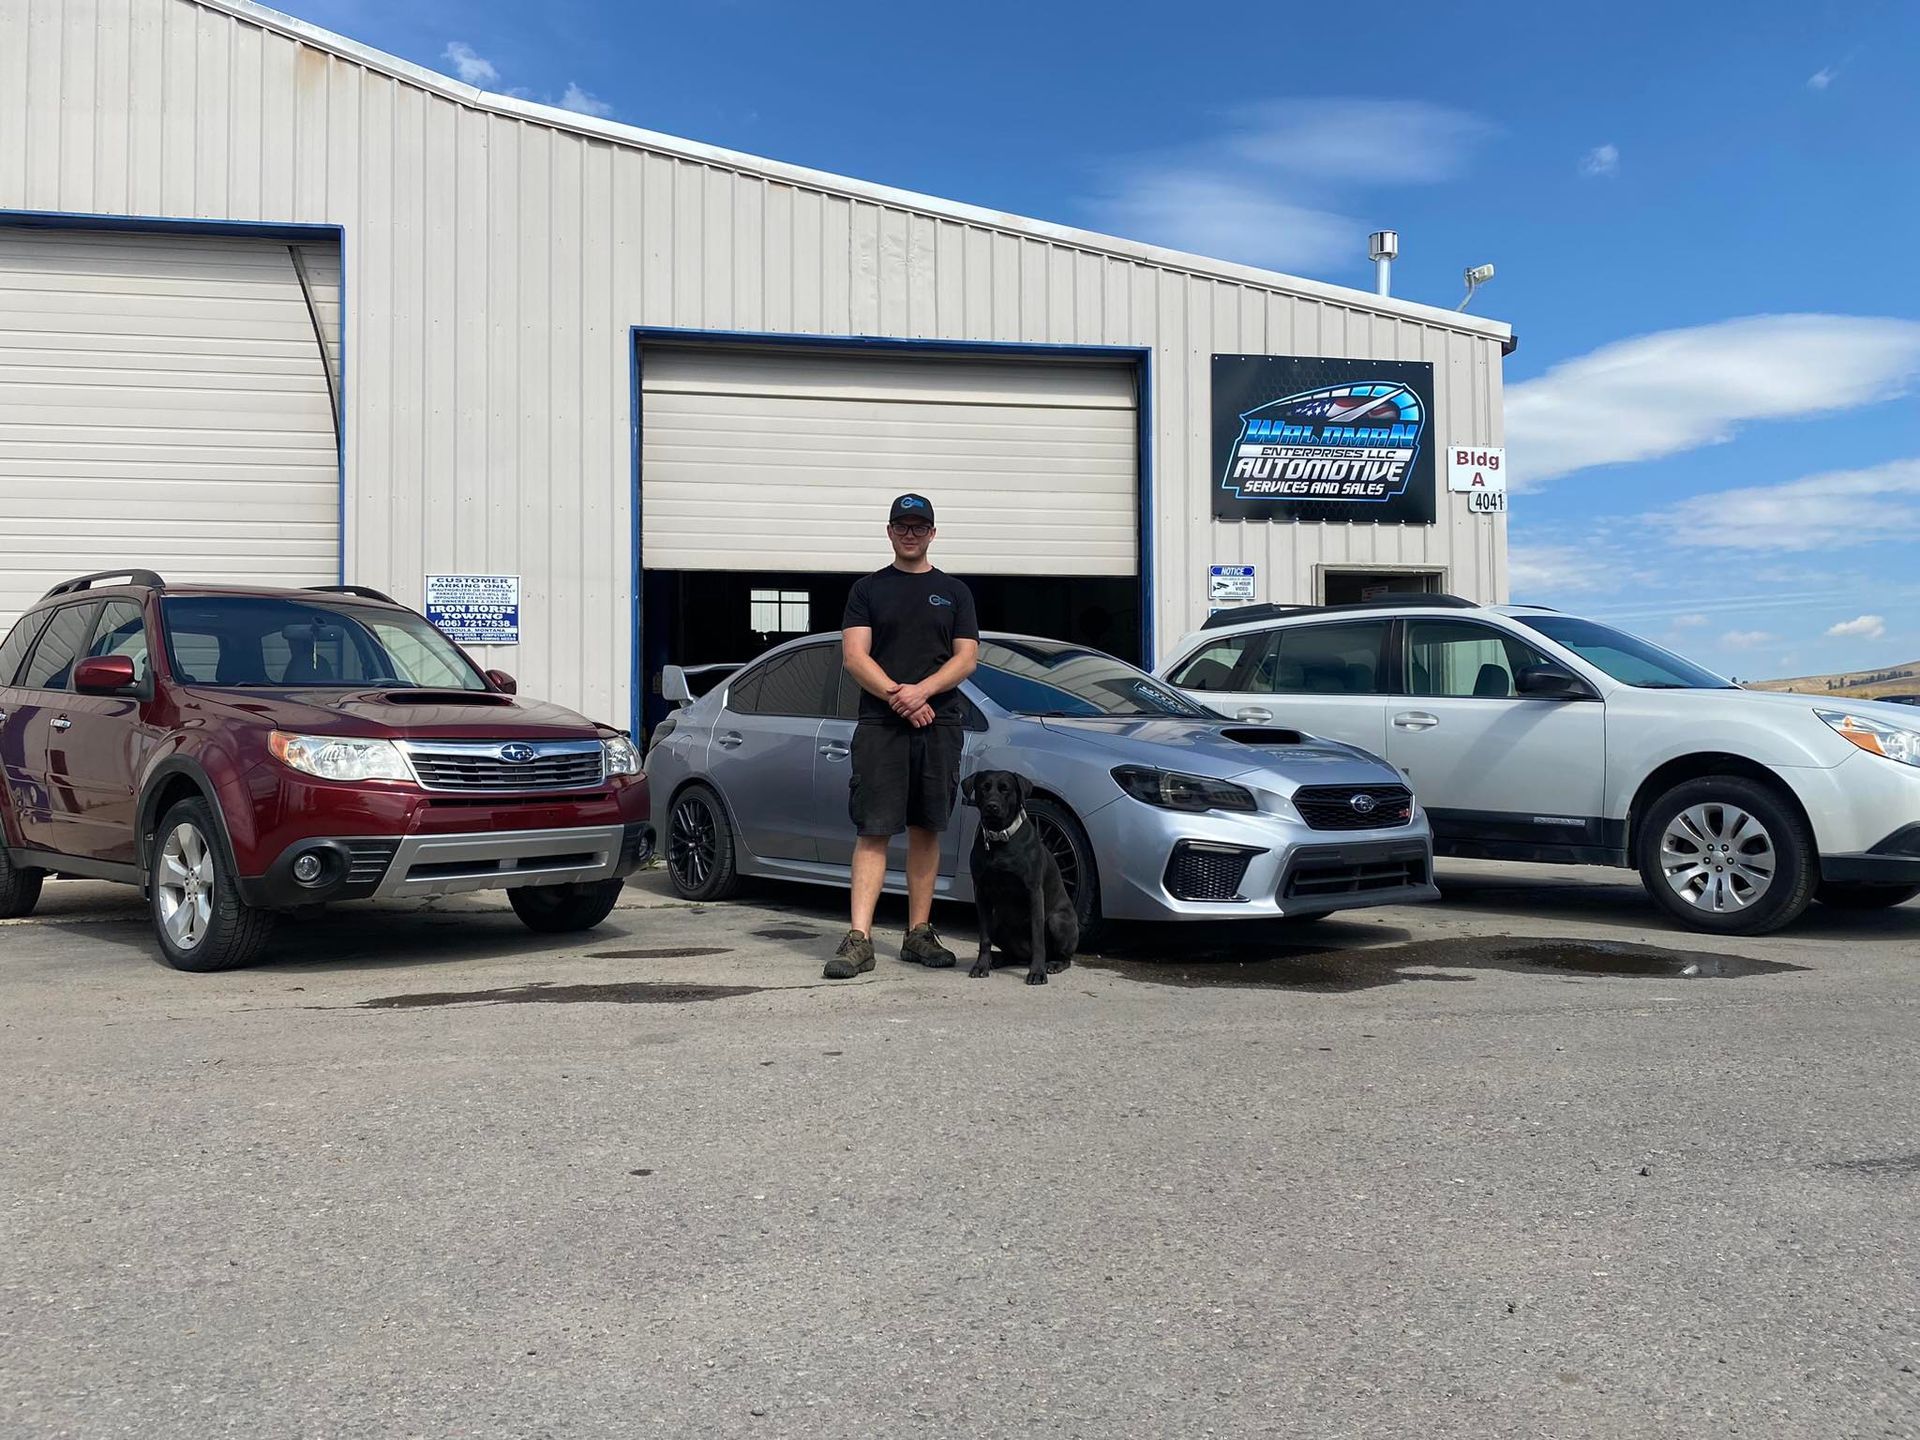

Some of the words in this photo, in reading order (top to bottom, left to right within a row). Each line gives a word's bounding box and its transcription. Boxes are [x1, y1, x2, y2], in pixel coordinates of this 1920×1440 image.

[1242, 418, 1418, 448] WALDMAN
[1261, 447, 1364, 458] ENTERPRISES
[1367, 450, 1396, 460] LLC
[1456, 450, 1500, 470] Bldg
[1233, 457, 1405, 482] AUTOMOTIVE
[1471, 472, 1485, 487] A
[1244, 480, 1308, 494] SERVICES
[1310, 482, 1339, 495] AND
[1341, 483, 1385, 496] SALES
[1475, 493, 1503, 511] 4041
[1220, 566, 1245, 576] NOTICE
[430, 605, 466, 613] IRON
[468, 605, 516, 614] HORSE
[435, 619, 461, 627] (406)
[464, 619, 511, 627] 721-7538
